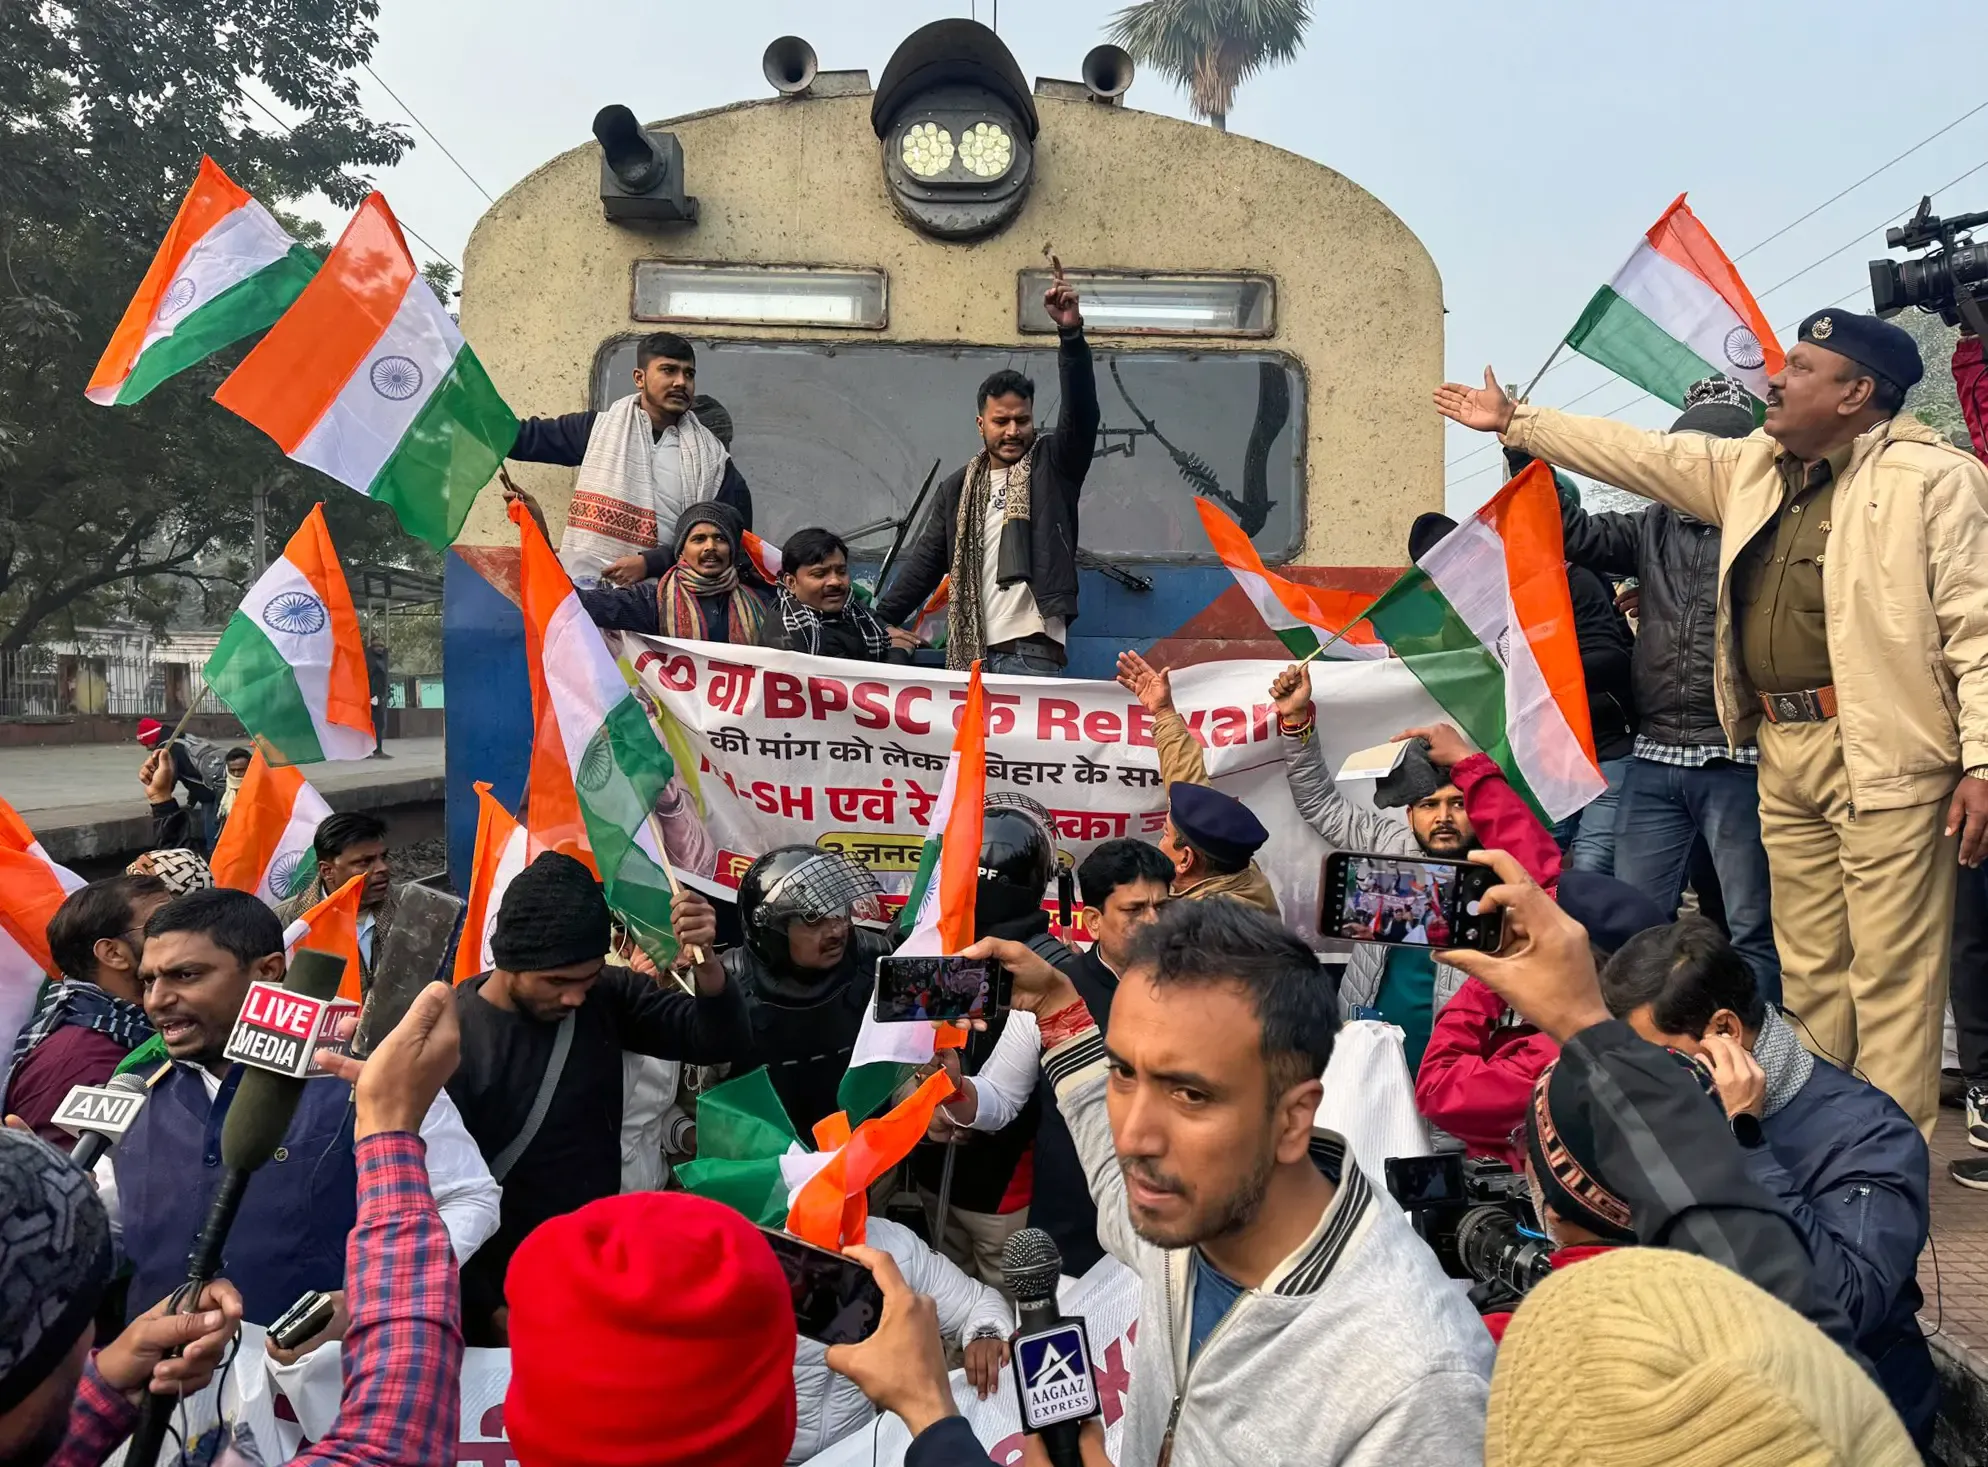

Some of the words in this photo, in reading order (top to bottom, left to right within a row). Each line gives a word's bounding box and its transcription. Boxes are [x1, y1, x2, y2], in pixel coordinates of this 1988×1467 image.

[763, 671, 932, 735] BPSC
[707, 726, 750, 755] की
[756, 732, 820, 760] मांग
[827, 735, 874, 764] को
[880, 741, 950, 772] लेक
[1073, 755, 1109, 784] के
[825, 778, 898, 824] एवं
[245, 991, 314, 1035] LIVE
[230, 1022, 298, 1068] MEDIA
[66, 1095, 130, 1122] ANI
[1032, 1378, 1086, 1406] AAGAAZ
[1034, 1395, 1089, 1419] EXPRESS
